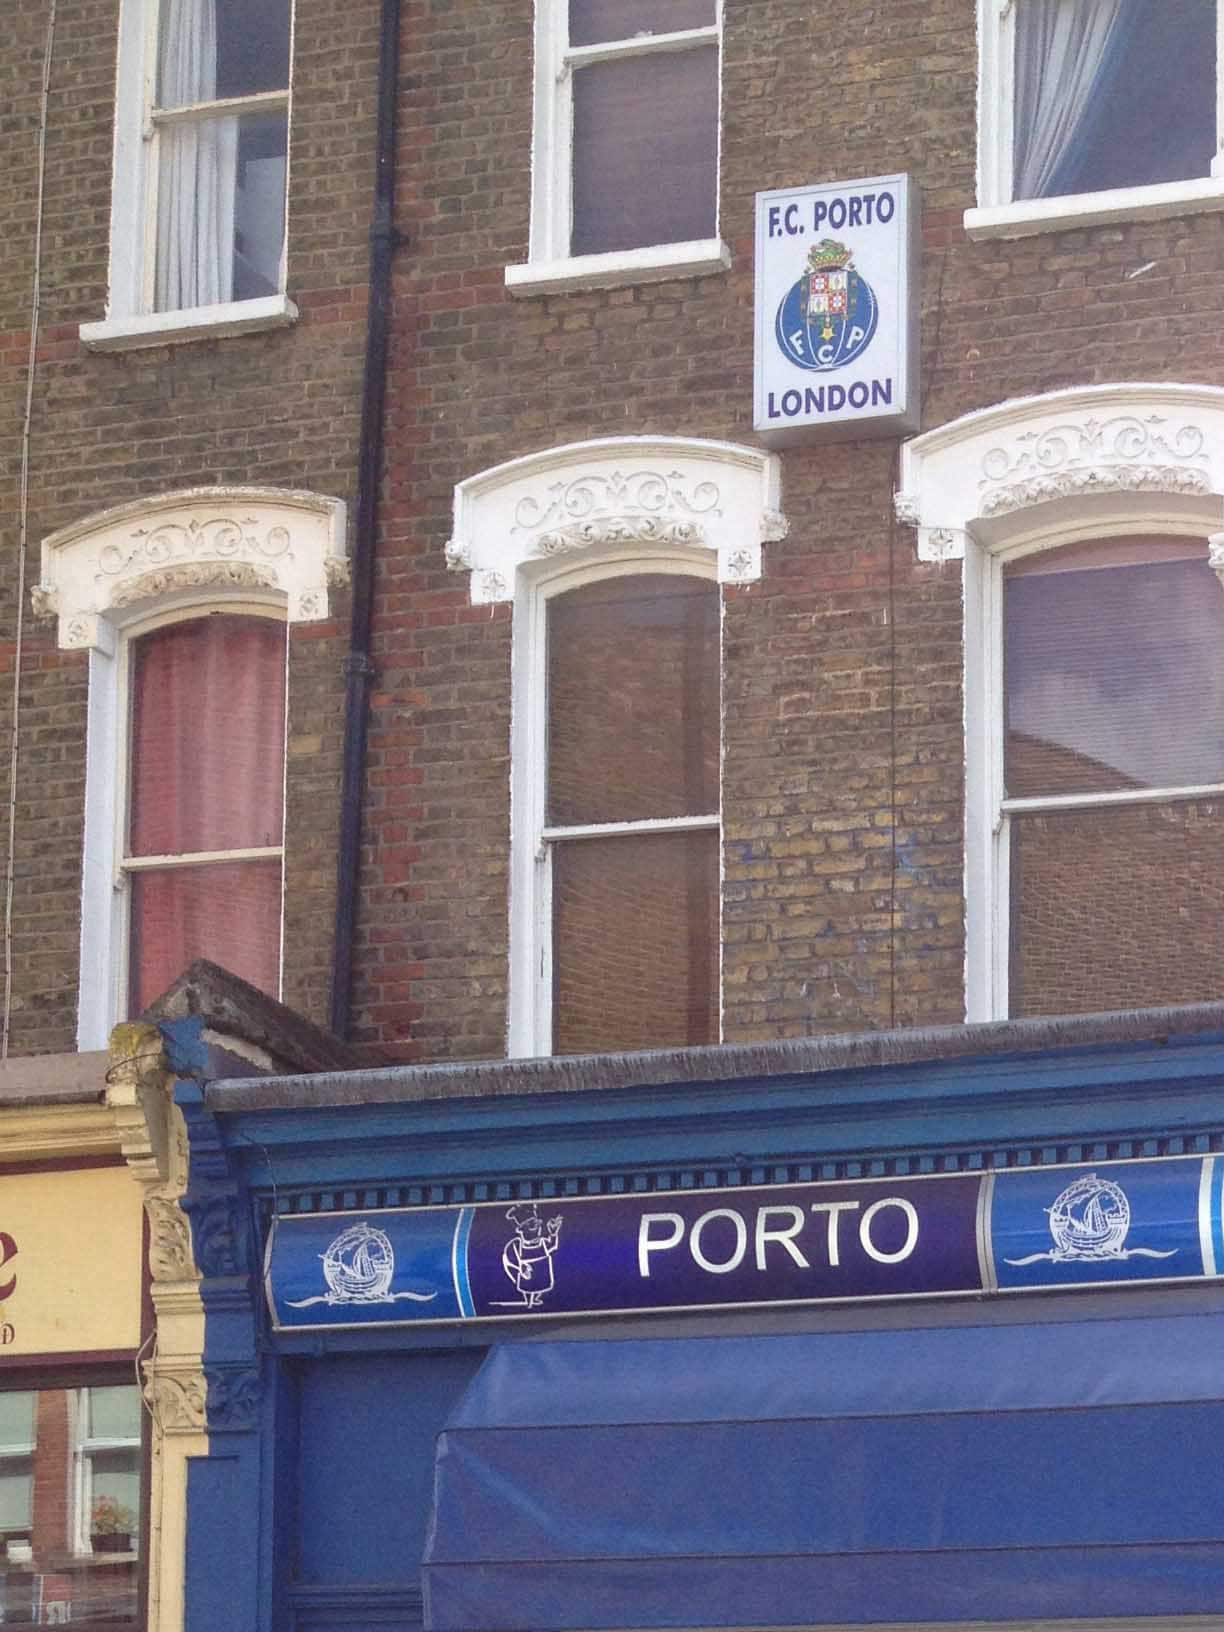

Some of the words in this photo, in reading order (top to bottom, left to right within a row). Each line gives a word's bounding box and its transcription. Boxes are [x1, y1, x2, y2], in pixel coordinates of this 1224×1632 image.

[768, 203, 805, 238] F.C.
[813, 191, 895, 232] PORTO
[767, 377, 893, 419] LONDON
[637, 1196, 920, 1278] PORTO
